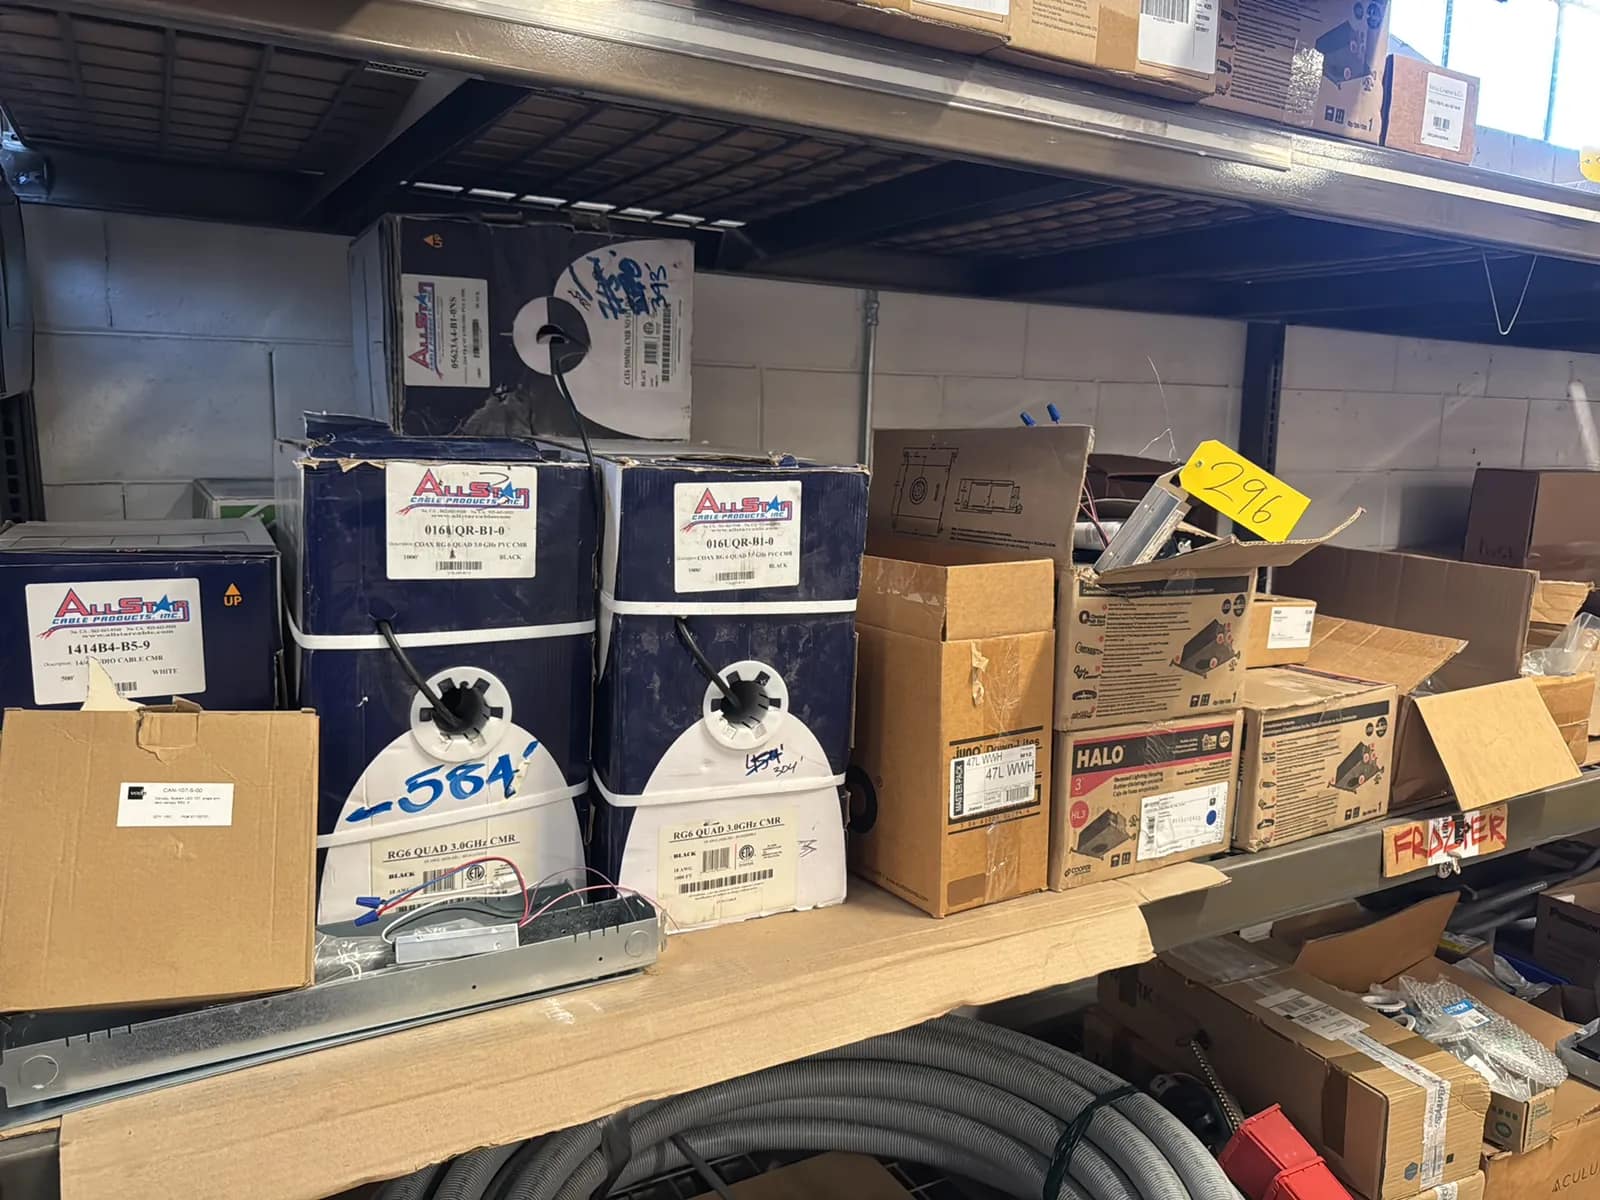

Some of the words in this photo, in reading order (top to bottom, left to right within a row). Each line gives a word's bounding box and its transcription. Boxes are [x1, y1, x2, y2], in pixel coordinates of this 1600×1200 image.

[1202, 461, 1283, 524] 296
[692, 513, 719, 521] CABLE
[223, 595, 243, 607] UP
[52, 616, 89, 625] CABLE
[67, 640, 151, 655] 1414B4-B5-9
[118, 656, 144, 664] CABLE
[1076, 745, 1124, 769] HALO
[985, 767, 1005, 781] 47L
[1007, 760, 1035, 777] WWH
[673, 831, 694, 840] RG6
[695, 825, 725, 838] QUAD
[726, 820, 758, 832] 3.0GHz
[759, 816, 781, 827] CMR
[388, 850, 411, 860] RG6
[414, 845, 448, 857] QUAD
[450, 839, 488, 852] 3.0GHz
[490, 834, 516, 845] CMR
[673, 851, 696, 859] BLACK
[389, 872, 415, 880] BLACK
[1551, 1159, 1600, 1193] ACULU
